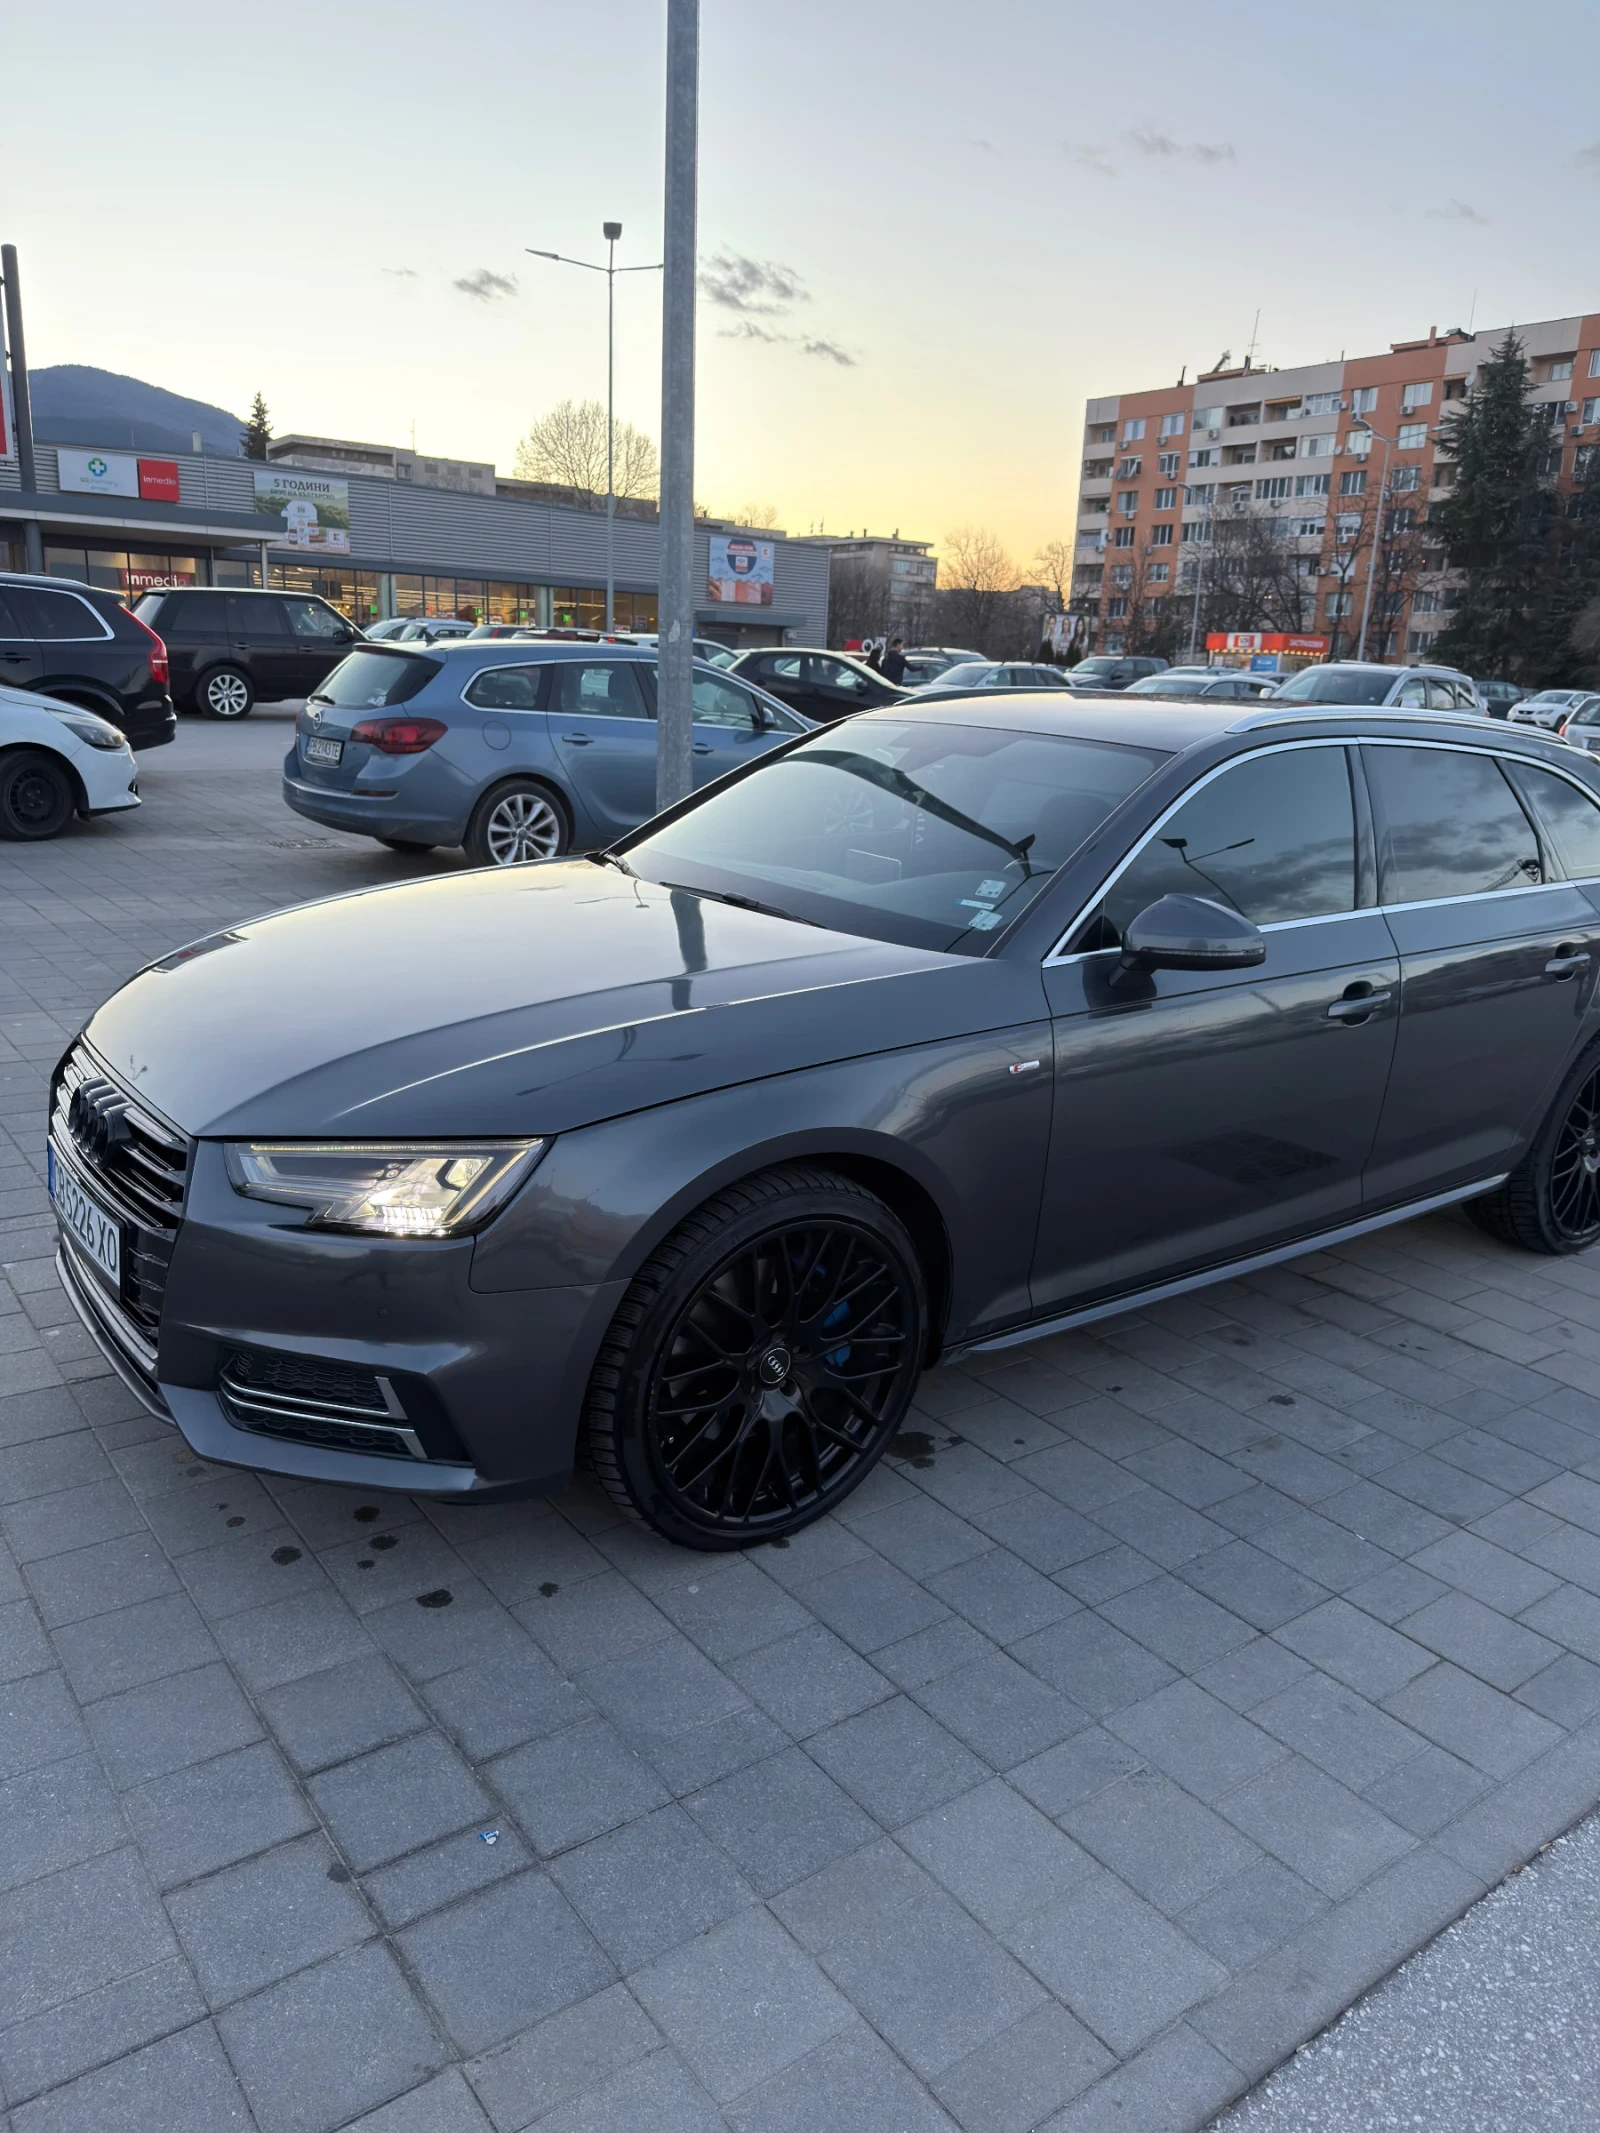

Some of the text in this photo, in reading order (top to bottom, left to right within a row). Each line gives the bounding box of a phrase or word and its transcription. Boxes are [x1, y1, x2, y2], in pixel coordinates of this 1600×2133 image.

[143, 475, 176, 486] inmedio
[274, 479, 330, 493] 5 ГОДИНИ
